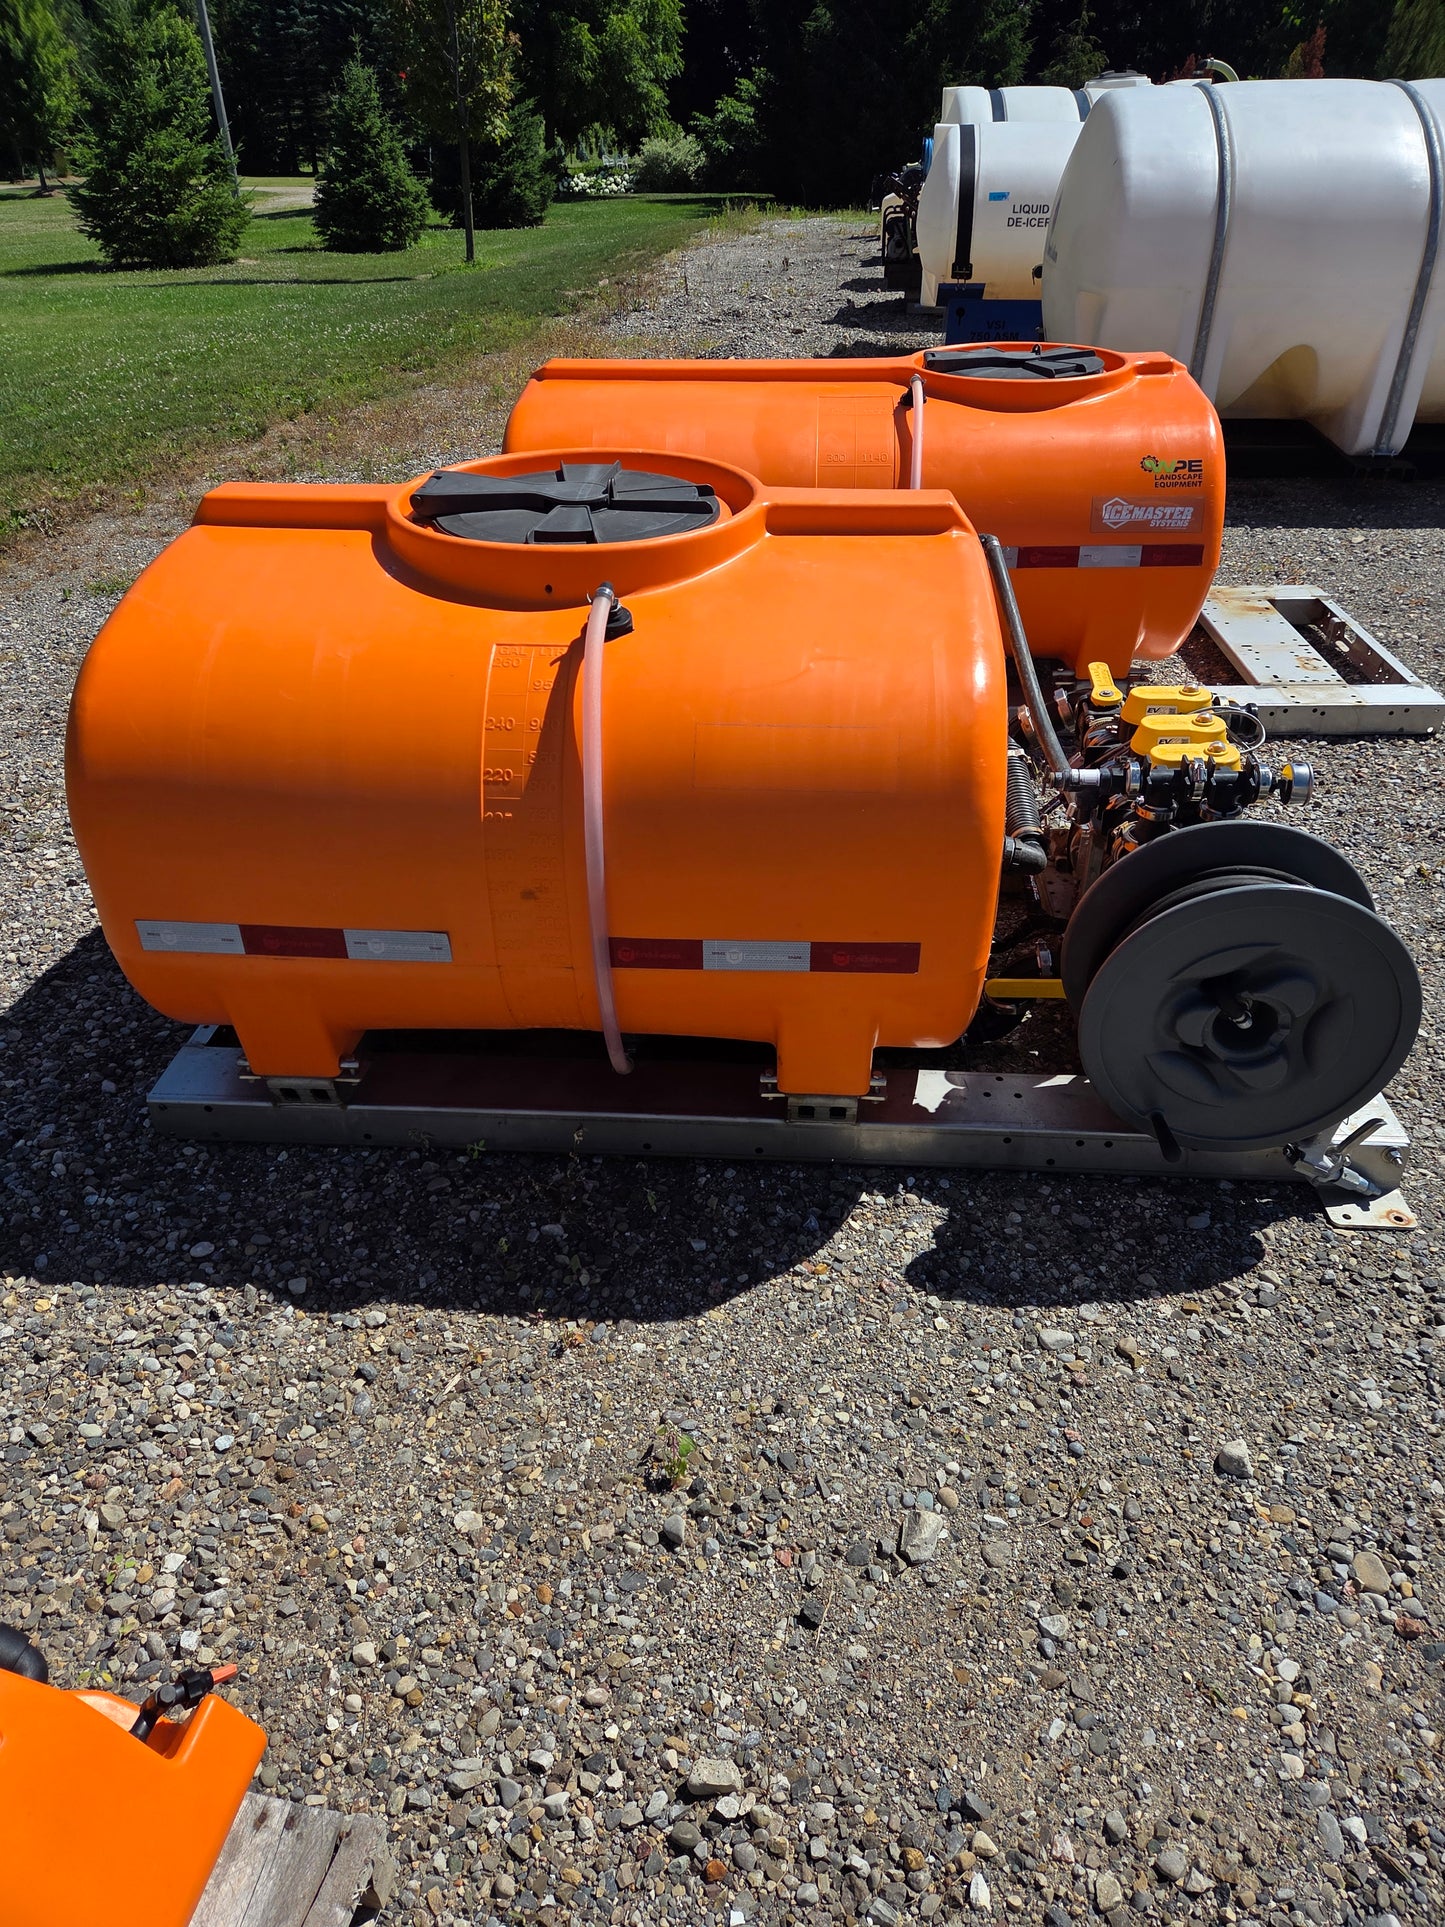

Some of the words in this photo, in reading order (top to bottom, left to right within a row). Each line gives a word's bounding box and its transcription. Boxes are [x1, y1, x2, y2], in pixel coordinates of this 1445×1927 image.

[1012, 204, 1050, 214] LIQUID
[986, 321, 1006, 329] VSI
[492, 657, 521, 668] 260
[485, 717, 515, 731] 240
[483, 768, 514, 783] 220
